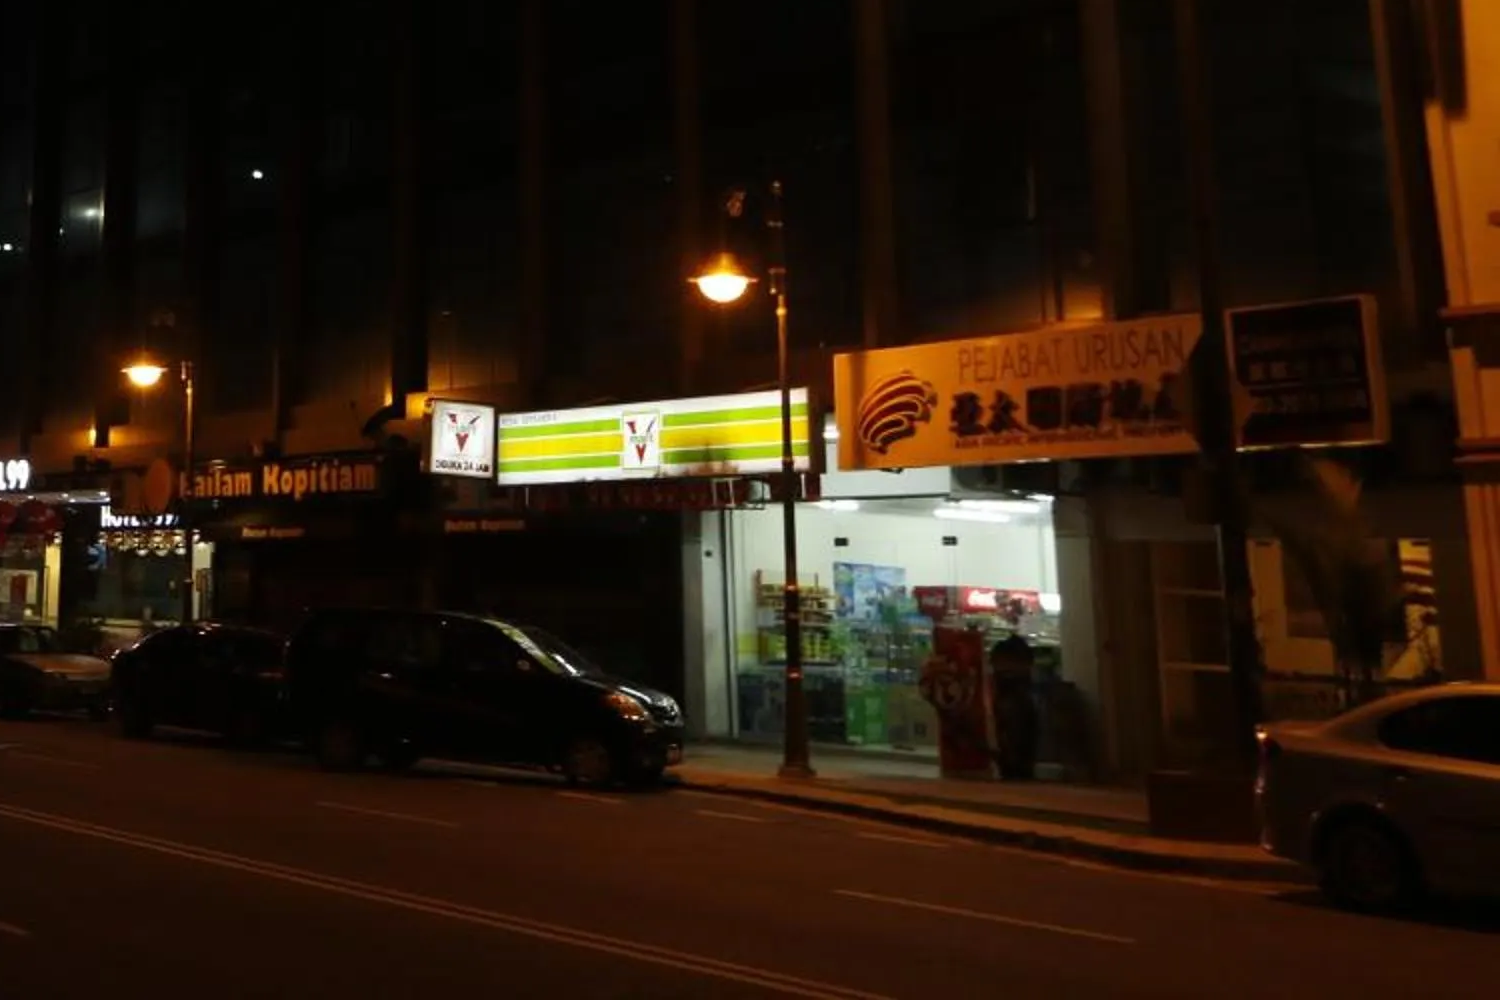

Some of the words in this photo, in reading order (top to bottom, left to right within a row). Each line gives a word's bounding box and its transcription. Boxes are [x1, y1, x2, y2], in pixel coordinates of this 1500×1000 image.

[957, 338, 1063, 384] PEJABAT
[1073, 327, 1185, 374] URUSAN
[7, 459, 30, 490] 99
[263, 459, 376, 502] Kopitiam
